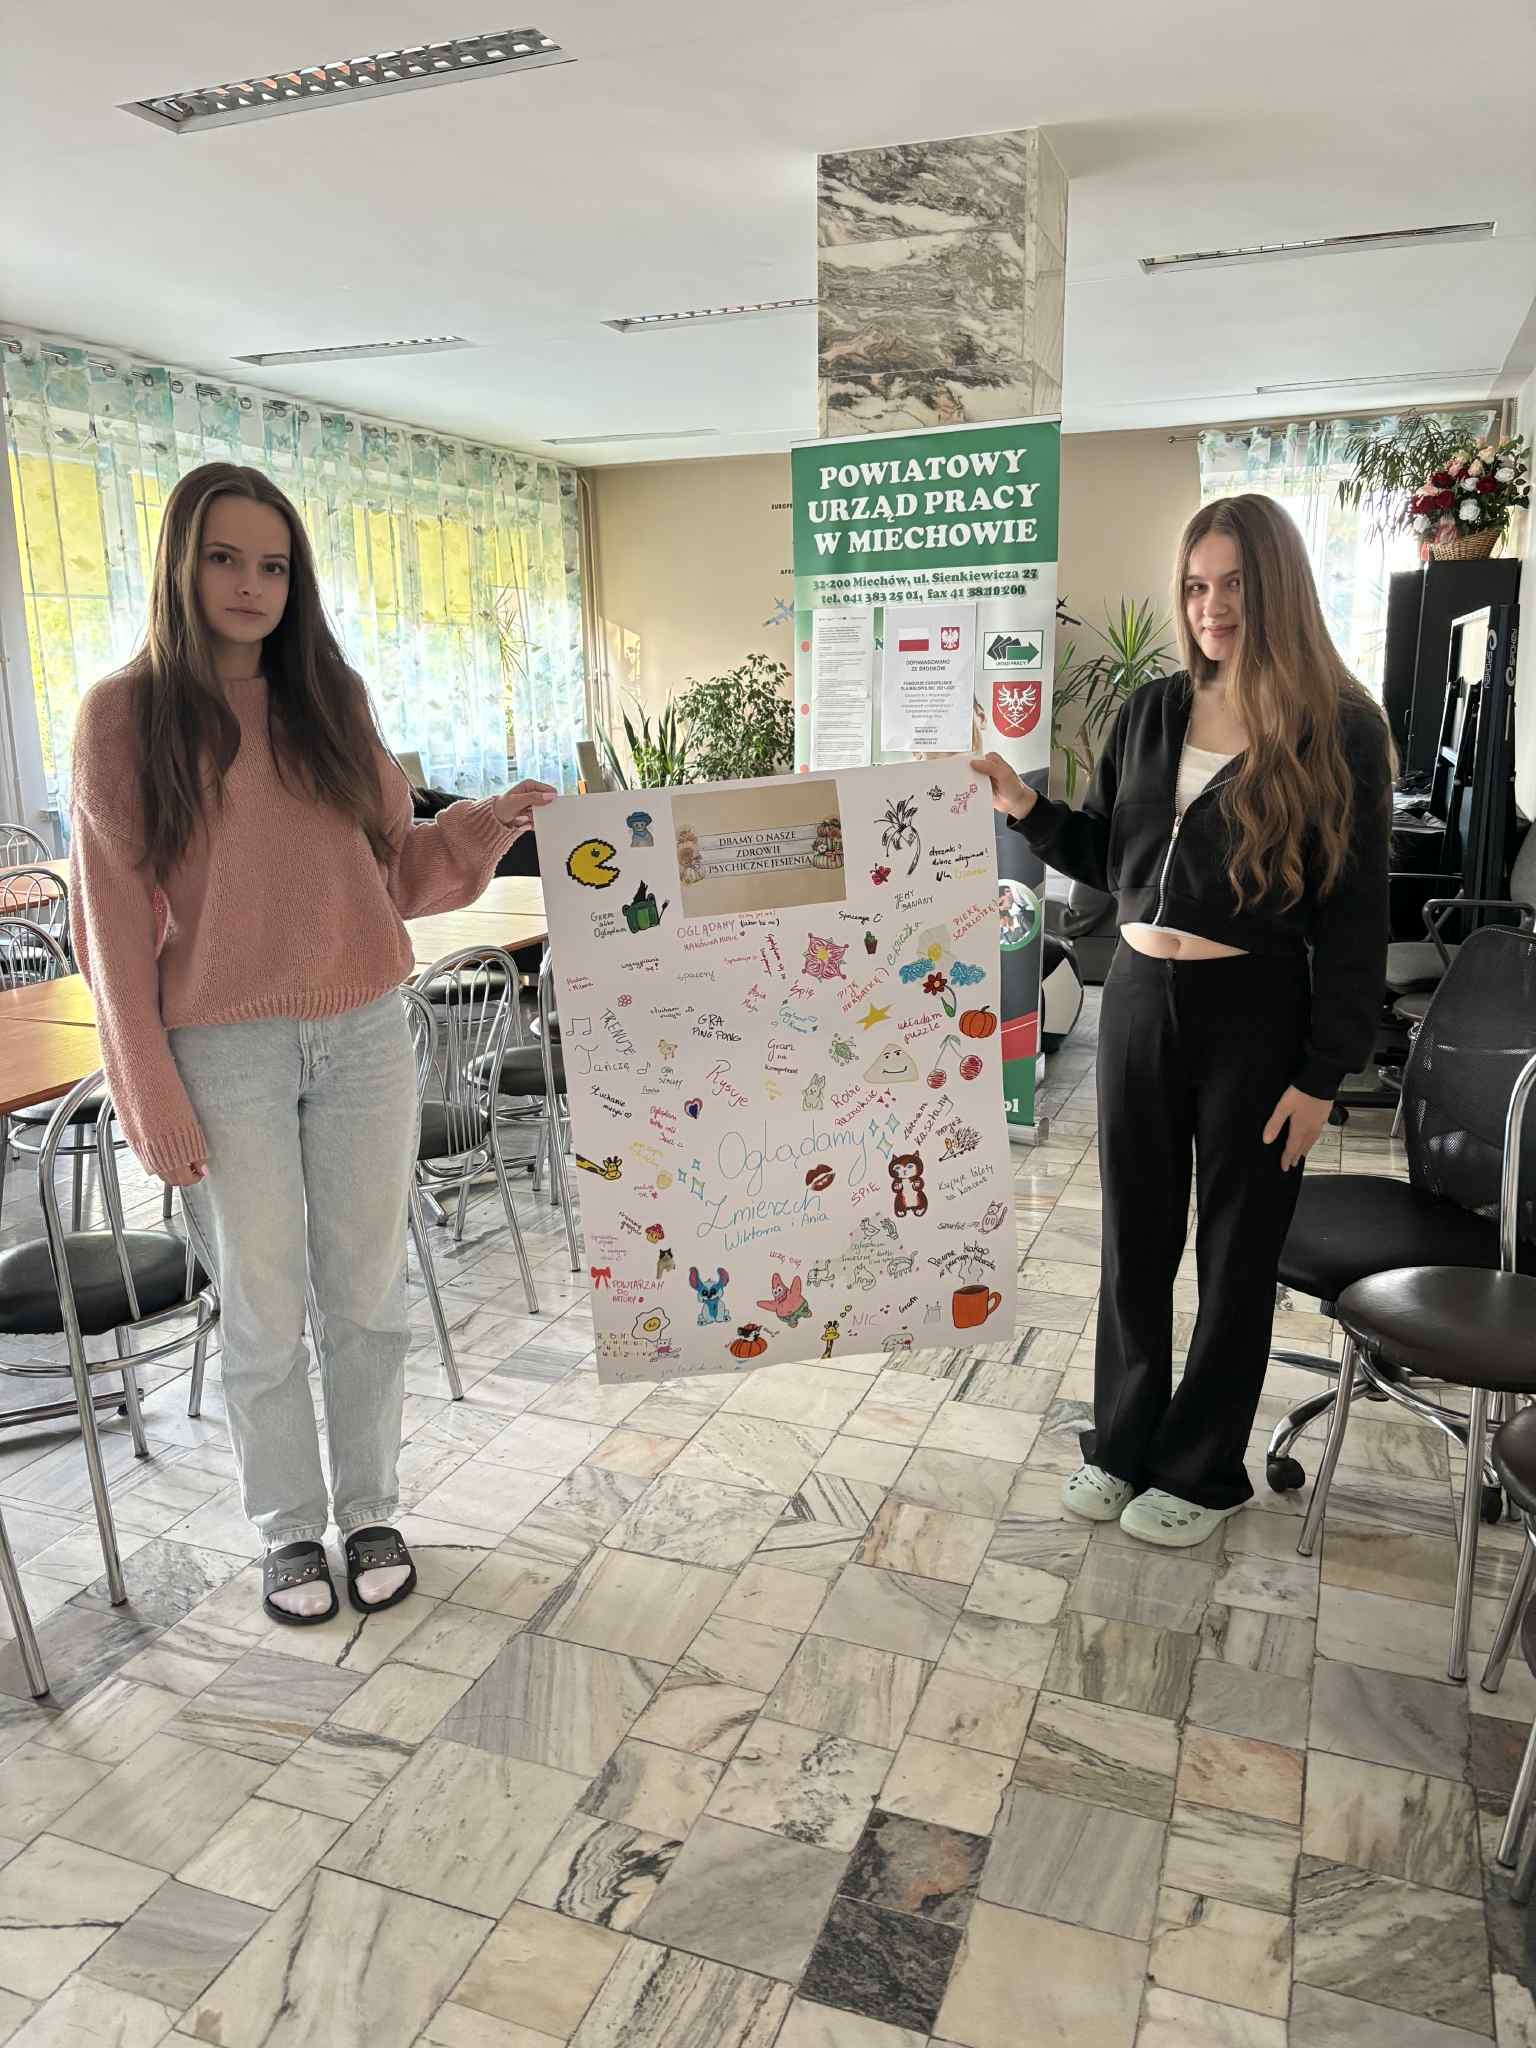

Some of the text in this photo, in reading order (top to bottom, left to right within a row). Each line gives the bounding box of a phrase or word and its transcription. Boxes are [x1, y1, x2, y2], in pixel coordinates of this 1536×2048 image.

[819, 448, 1027, 490] POWIATOWY
[808, 483, 1040, 523] URZĄD PRACY
[814, 519, 1038, 556] W MIECHOWIE
[813, 579, 850, 591] 32-200
[853, 574, 911, 588] Miechów,
[914, 573, 930, 585] ul.
[932, 569, 1018, 584] Sienkiewicza
[821, 593, 841, 604] tel.
[865, 590, 887, 604] 383
[927, 588, 948, 600] fax
[719, 831, 797, 847] DBAMY O NASZE
[708, 861, 768, 874] PSYCHICZNE
[697, 1014, 726, 1027] GRA
